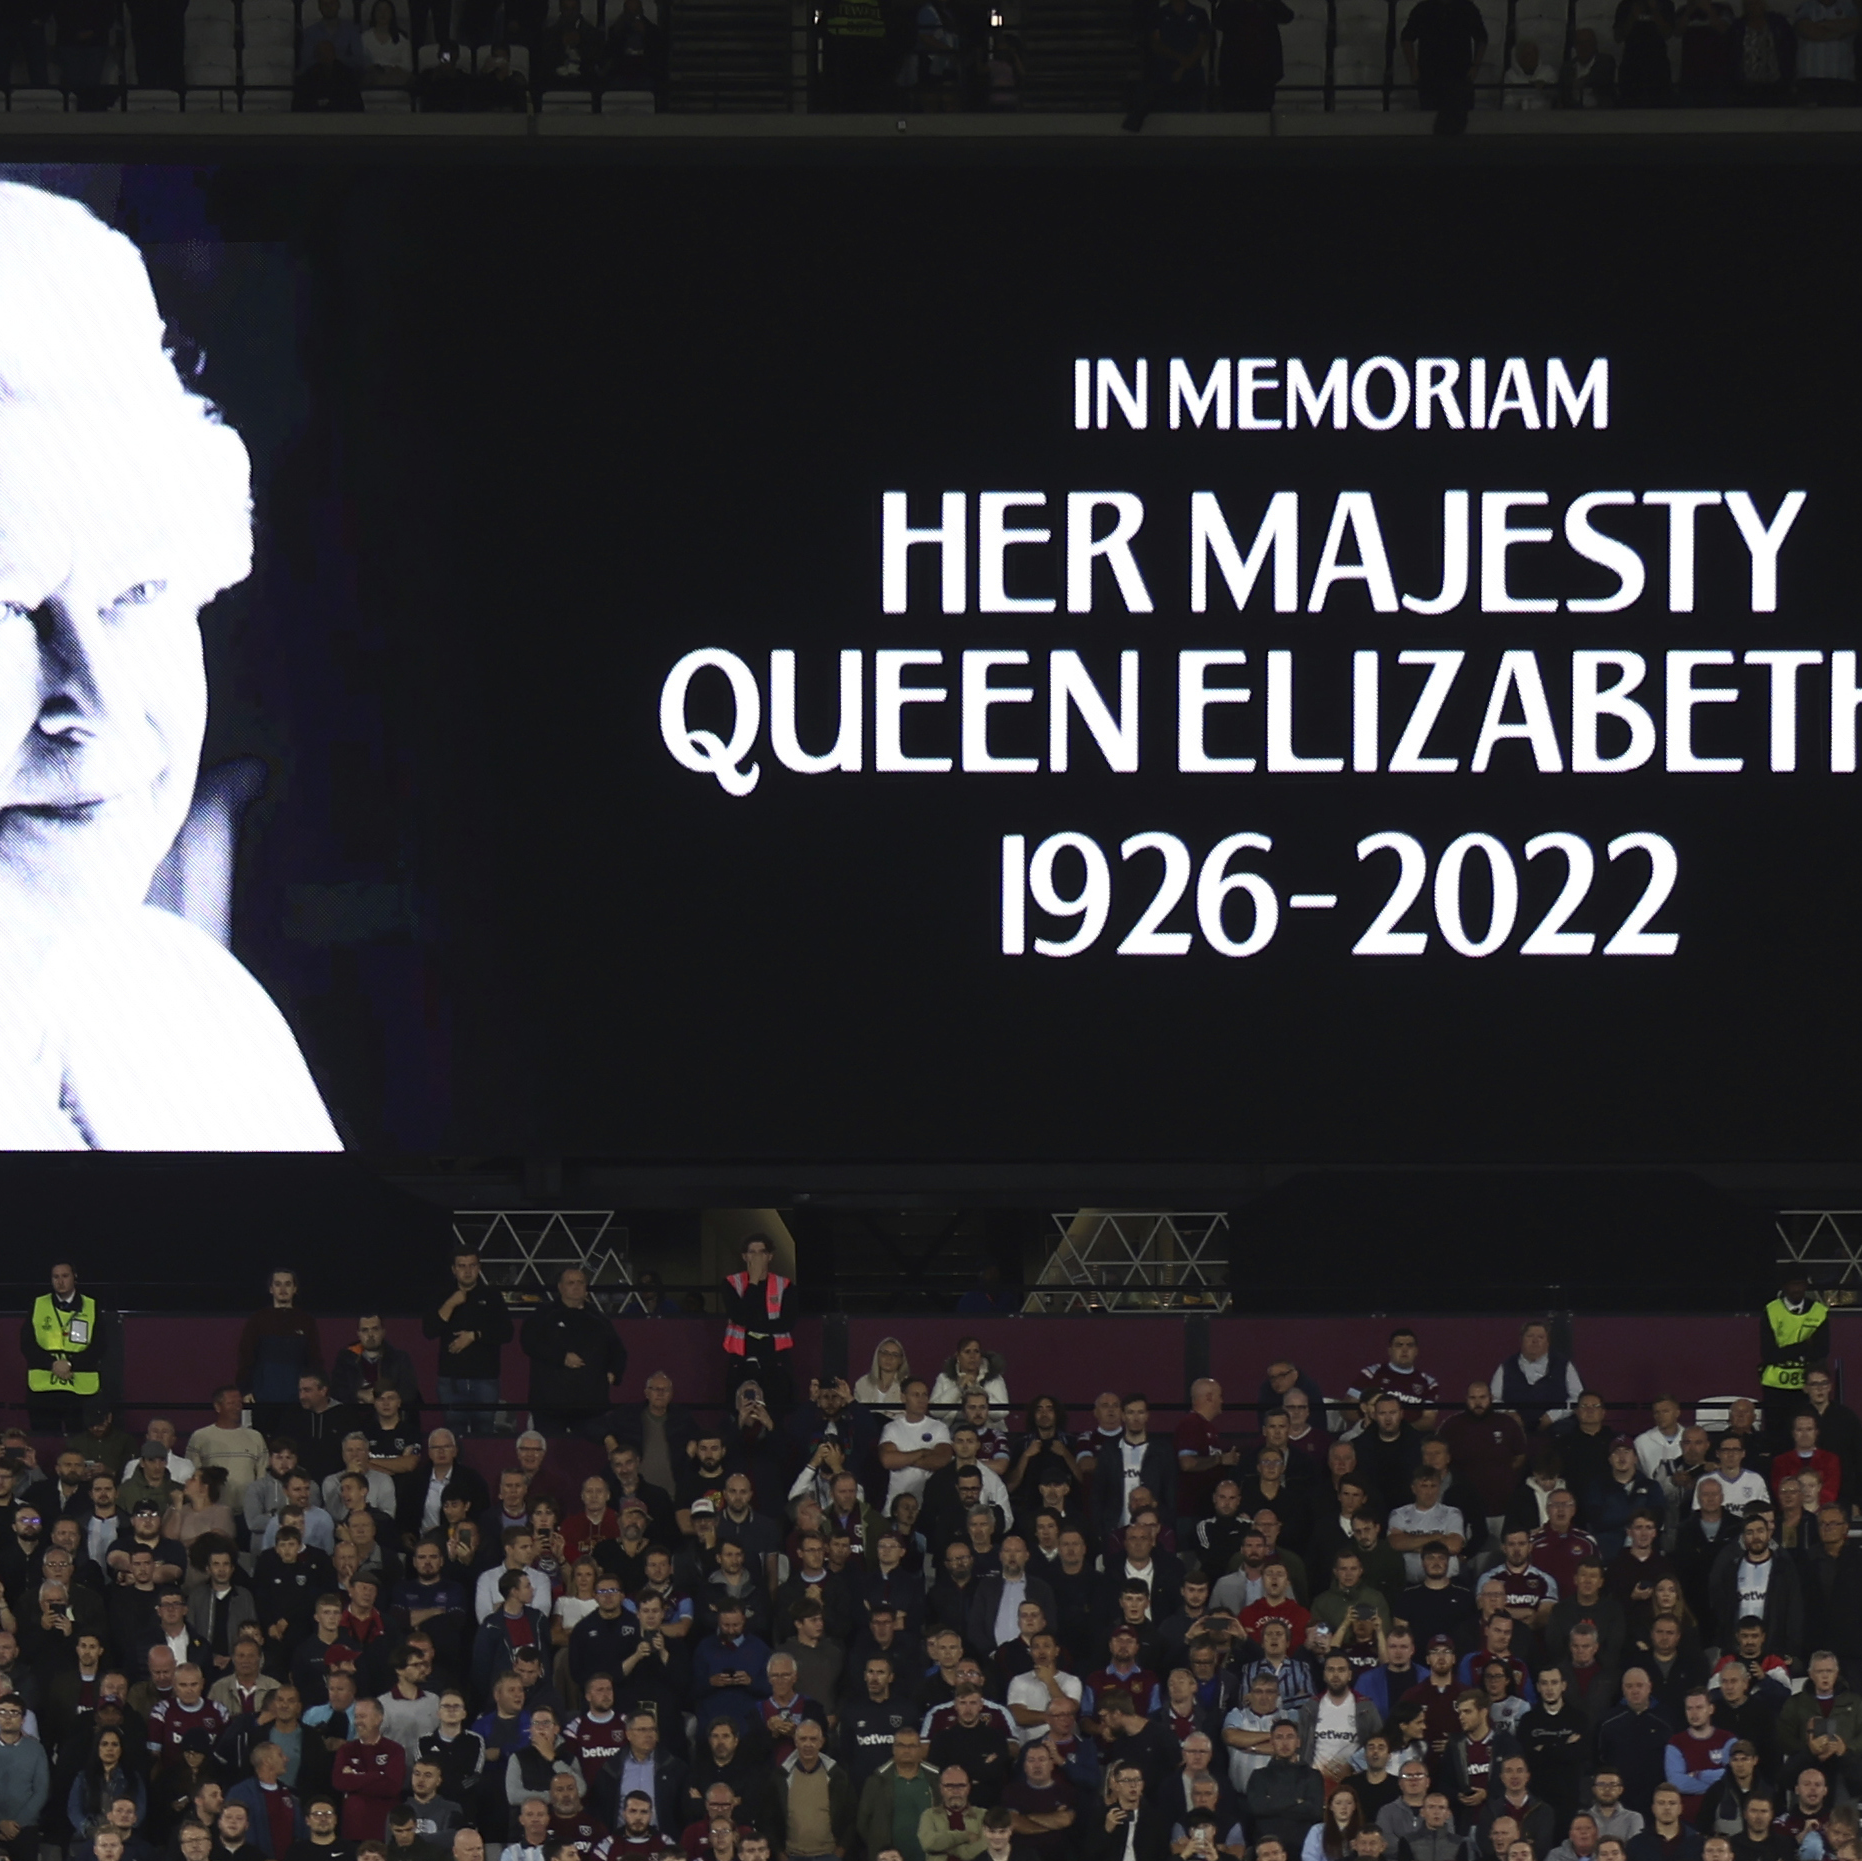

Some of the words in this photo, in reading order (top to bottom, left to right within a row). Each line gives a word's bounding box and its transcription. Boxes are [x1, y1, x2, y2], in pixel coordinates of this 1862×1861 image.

[1075, 359, 1147, 429] IN
[1170, 356, 1608, 430] MEMORIAM
[883, 492, 1153, 614] HER
[1191, 490, 1806, 614] MAJESTY
[660, 648, 1138, 796] QUEEN
[856, 1734, 895, 1745] betwa
